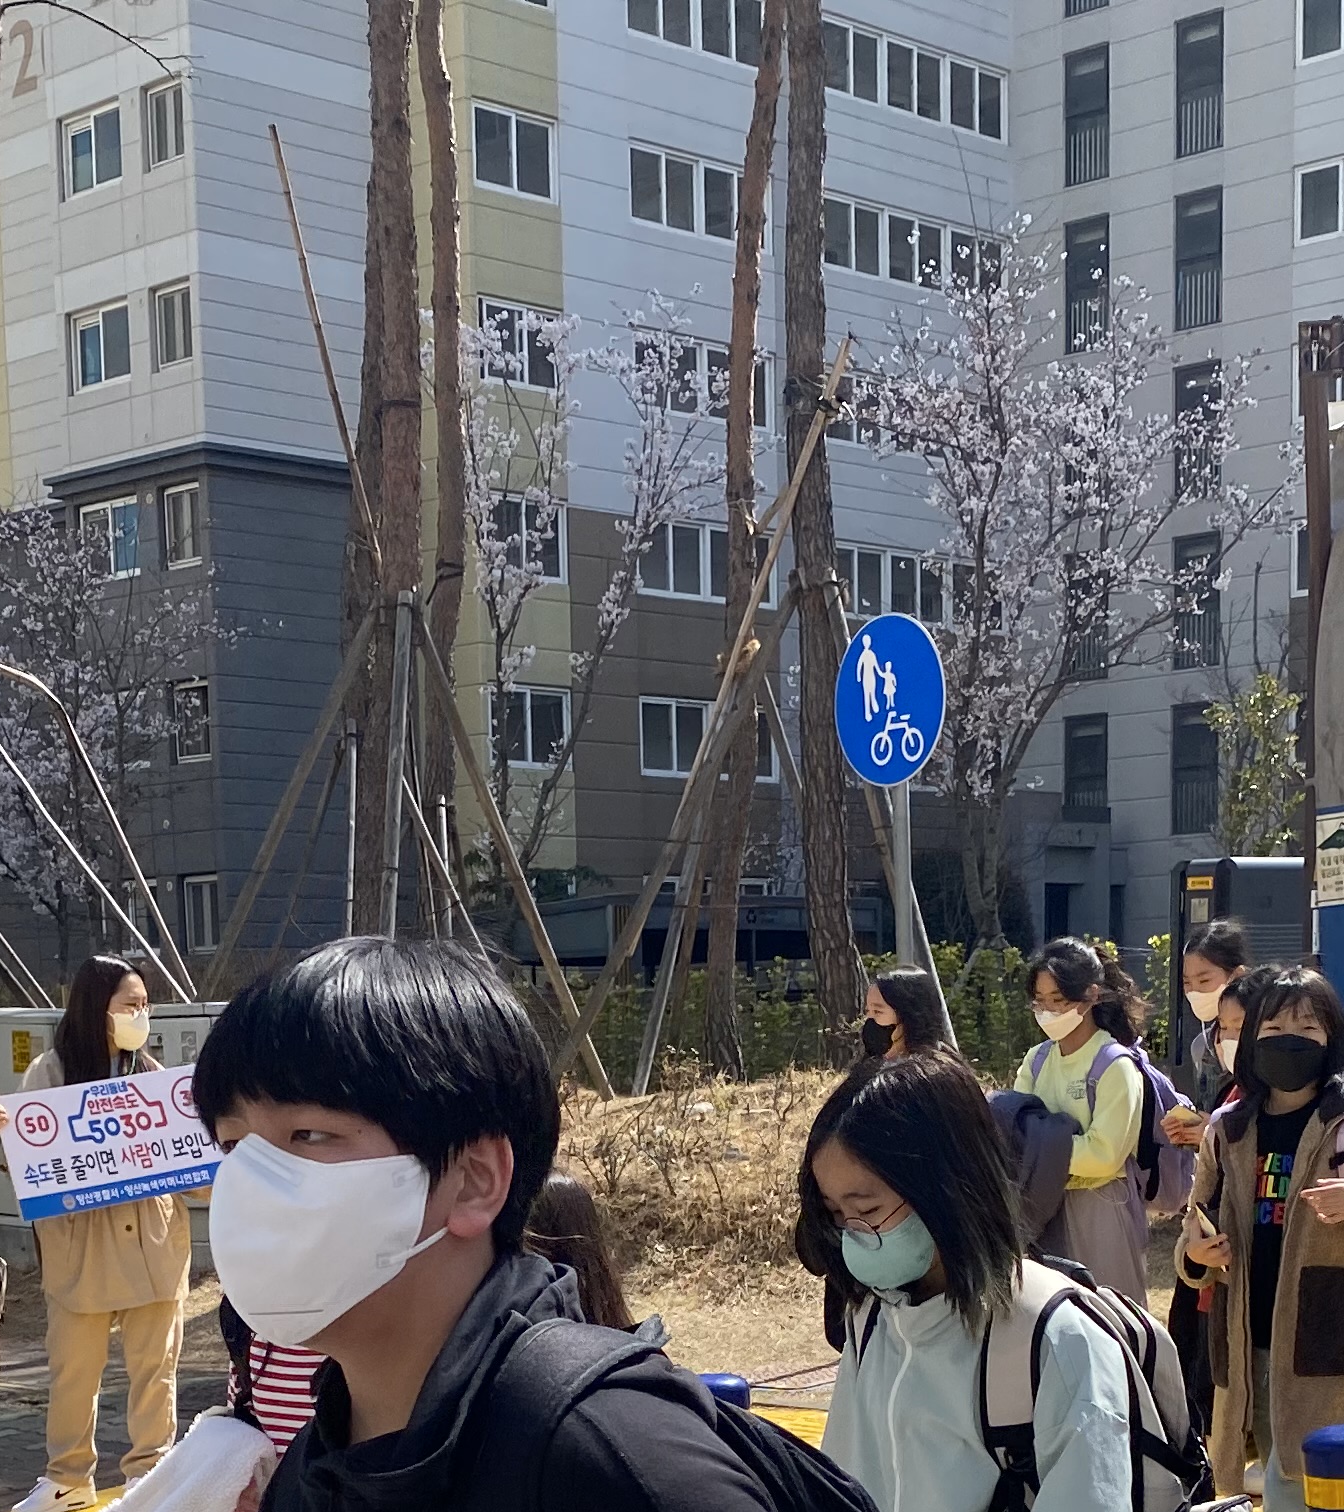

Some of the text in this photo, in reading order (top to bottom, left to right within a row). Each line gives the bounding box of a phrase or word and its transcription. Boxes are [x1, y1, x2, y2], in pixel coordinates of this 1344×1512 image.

[90, 1081, 128, 1096] 우리동네
[87, 1093, 139, 1115] 안전속도
[24, 1115, 50, 1134] 50
[88, 1111, 152, 1144] 5030
[24, 1132, 218, 1189] 속도를 줄이면 사람이 보입니
